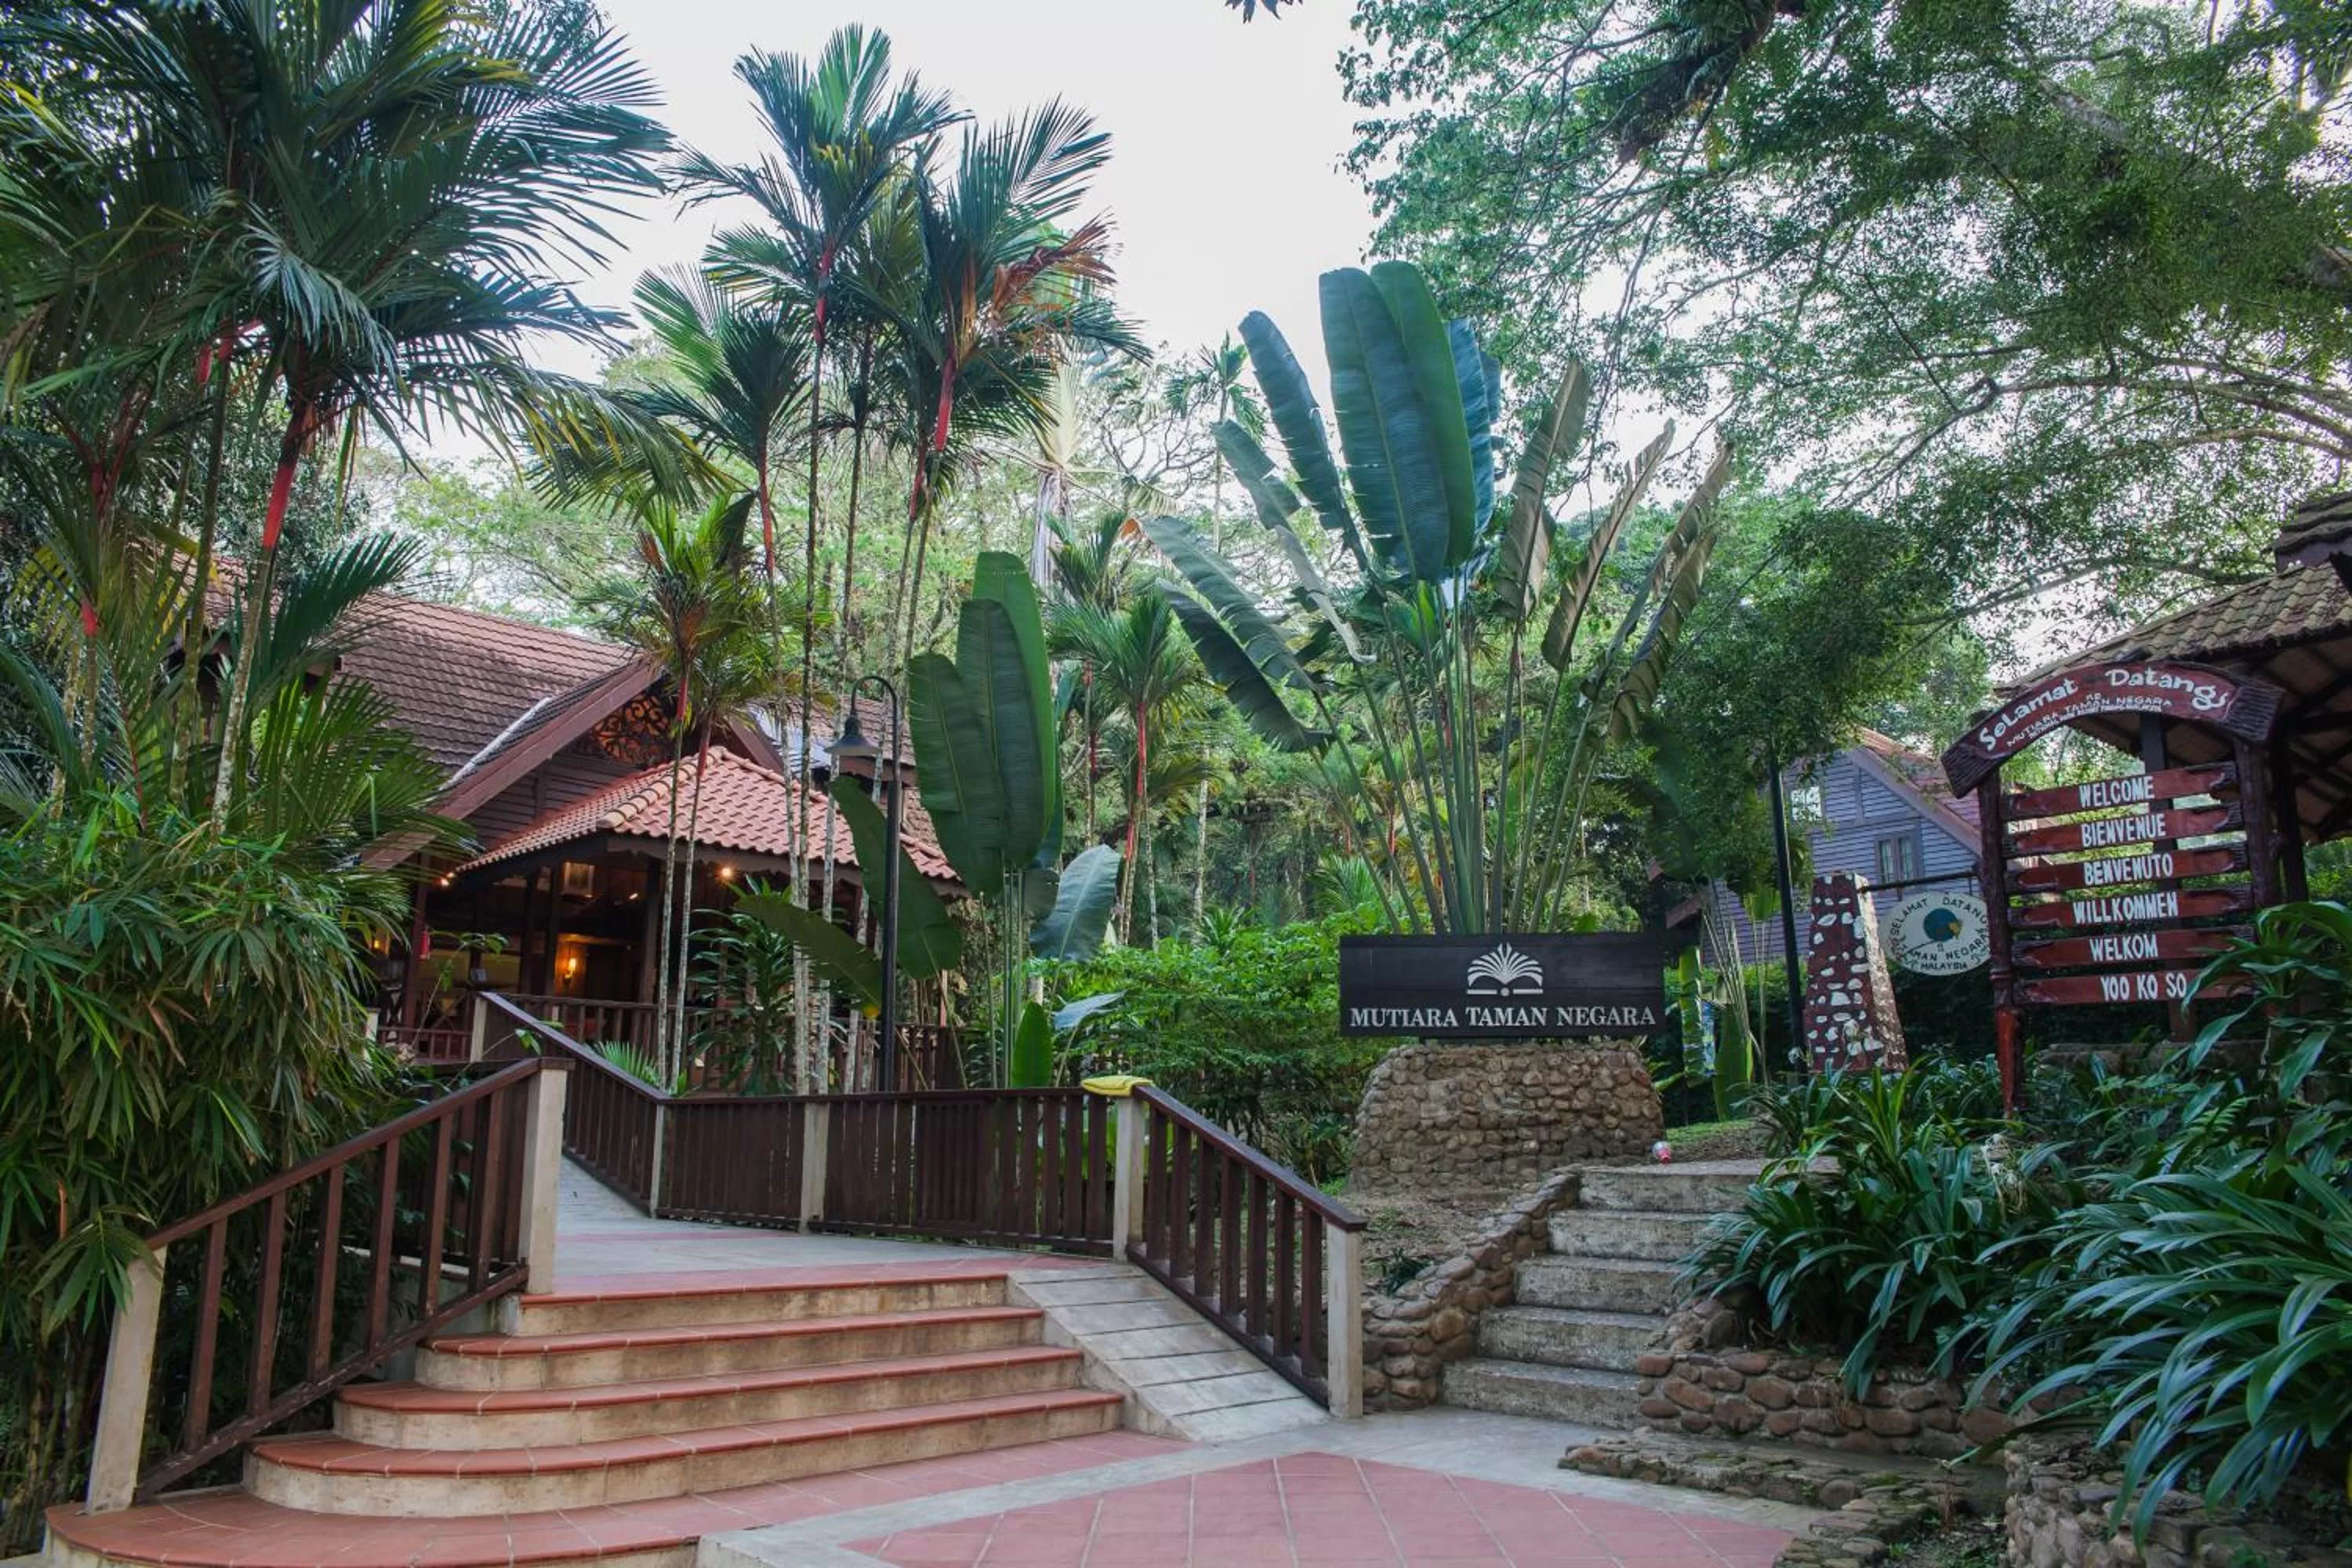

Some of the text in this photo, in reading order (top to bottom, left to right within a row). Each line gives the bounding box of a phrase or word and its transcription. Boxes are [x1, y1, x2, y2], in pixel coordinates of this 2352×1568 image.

[2079, 775, 2155, 808] WELCOME
[2082, 813, 2166, 848] BIENVENUE
[2083, 853, 2174, 885] BENVENUTO
[1890, 898, 1928, 935] SELAMAT
[2073, 891, 2179, 924] WILLKOMMEN
[2089, 934, 2158, 962] WELKOM
[1921, 962, 1968, 971] MALAYSIA
[2101, 972, 2187, 1002] YOO KO SO
[1350, 1006, 1657, 1029] MUTIARA TAMAN NEGARA
